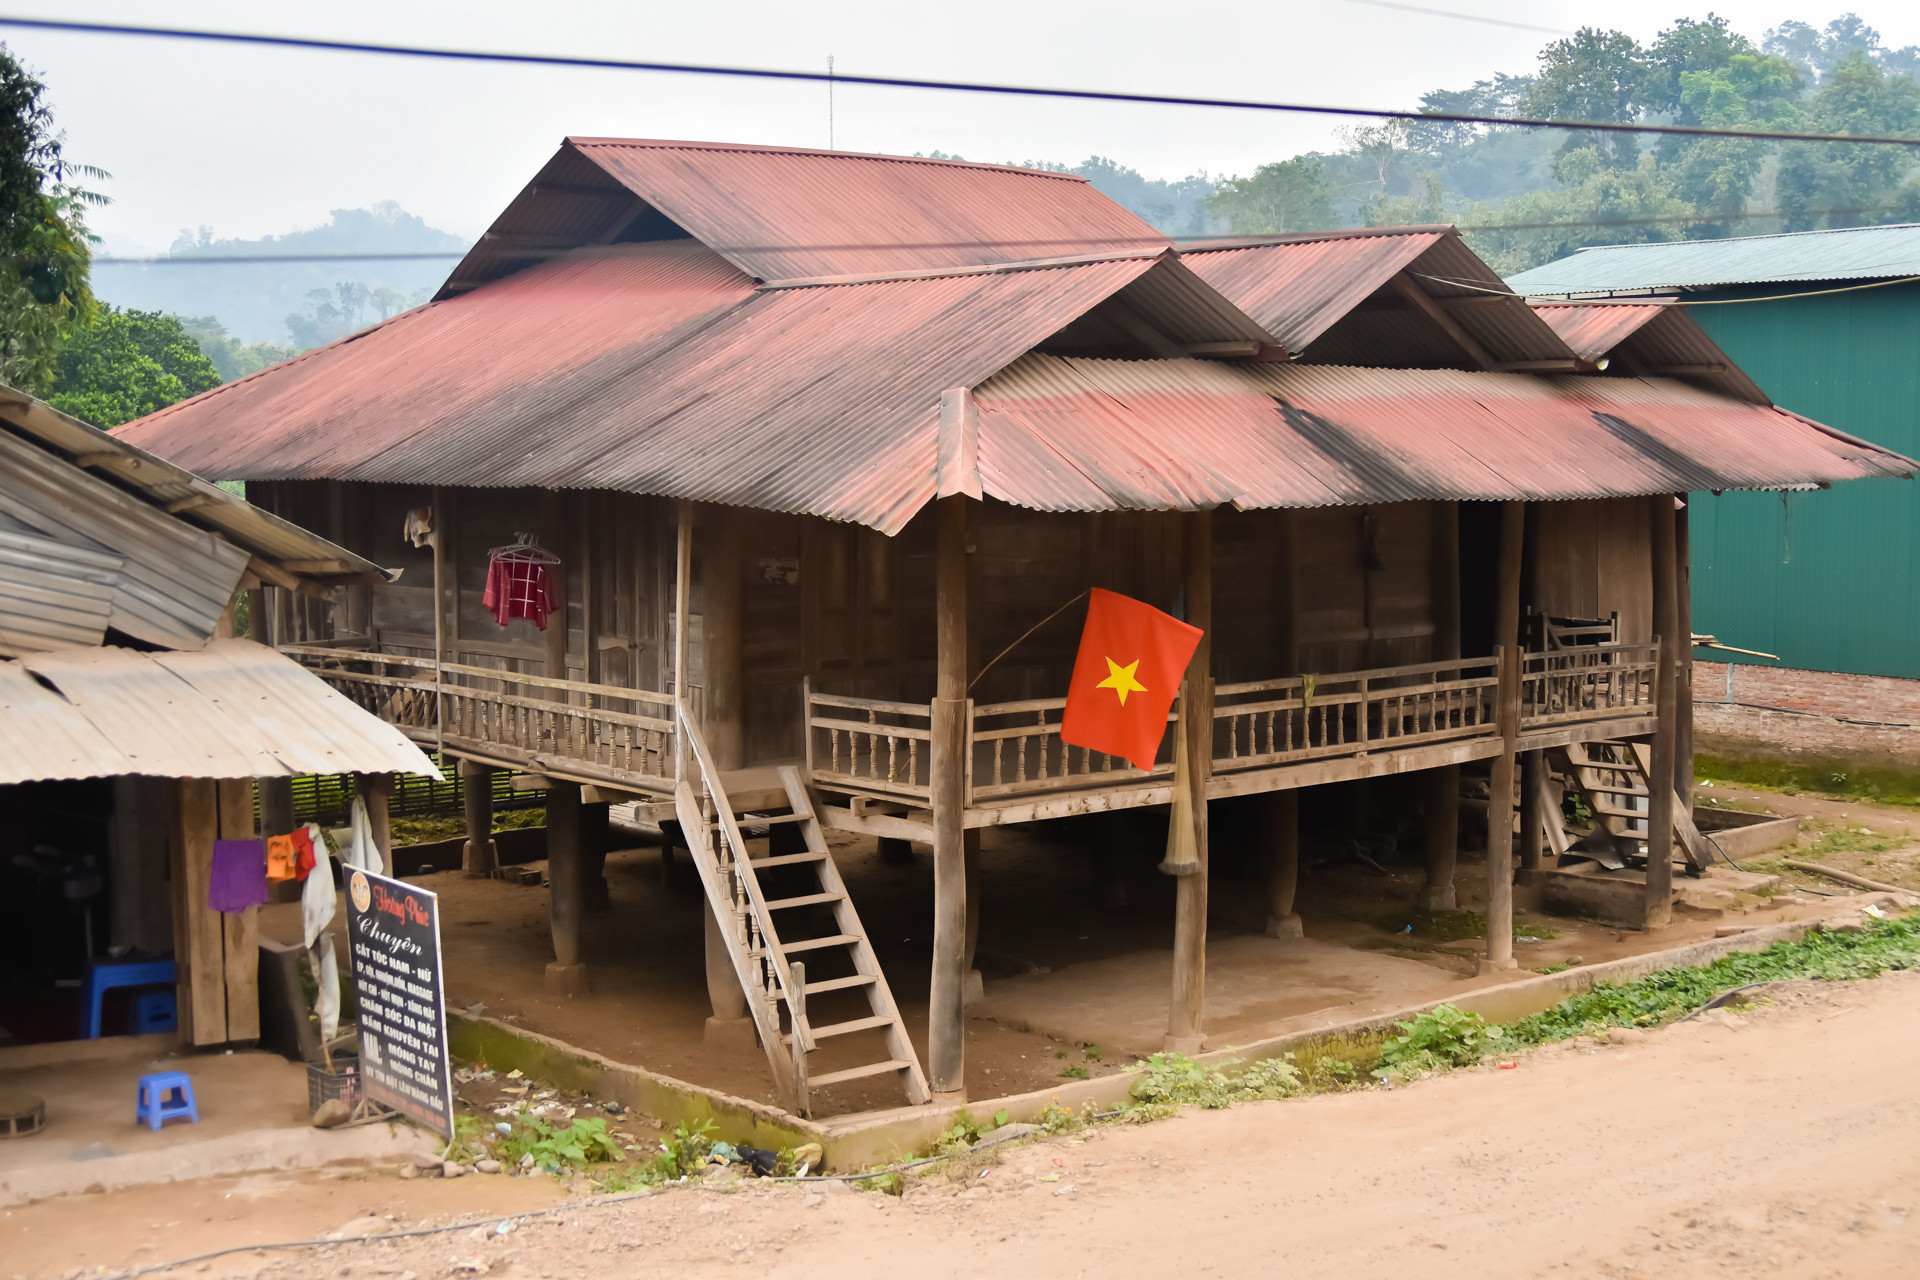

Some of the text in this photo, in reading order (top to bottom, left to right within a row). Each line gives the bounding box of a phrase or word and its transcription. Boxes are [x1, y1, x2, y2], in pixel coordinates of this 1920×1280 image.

[357, 915, 423, 956] Chuyên
[372, 950, 388, 966] TÓC
[390, 957, 410, 974] NAM
[385, 1008, 402, 1024] SÓC
[384, 1025, 421, 1050] KHUYÊN
[423, 1042, 439, 1058] TAI
[388, 1043, 416, 1065] MÓNG
[418, 1056, 436, 1073] TAY
[390, 1059, 413, 1079] MÓNG
